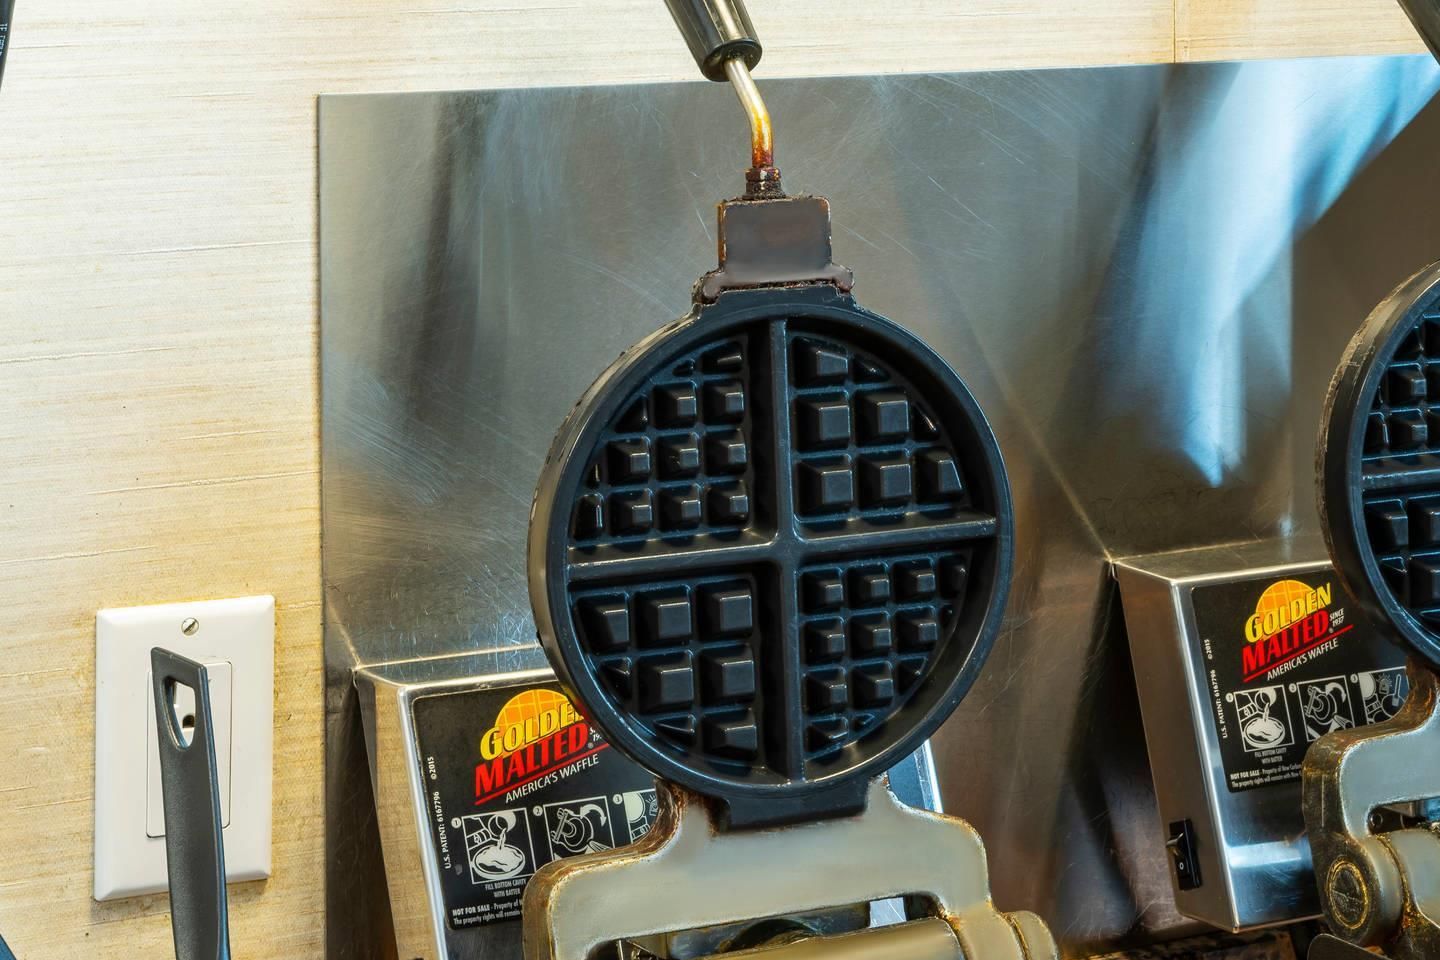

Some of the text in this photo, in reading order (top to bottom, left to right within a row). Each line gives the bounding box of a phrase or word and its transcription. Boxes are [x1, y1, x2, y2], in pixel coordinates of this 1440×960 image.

[1245, 582, 1332, 643] GOLDEN
[1329, 607, 1344, 621] SINCE
[1332, 615, 1344, 627] 1937
[1243, 609, 1329, 674] MALTED
[1267, 638, 1338, 680] AMERICA'S WAFFLE
[480, 702, 584, 760] GOLDE
[1216, 698, 1225, 725] PATENT:
[475, 722, 588, 798] MALTED
[505, 753, 600, 804] AMERICA'S WAFFLE
[432, 791, 452, 869] U.S. PATENT: 6167796
[452, 908, 464, 917] NOT
[465, 906, 476, 915] FOR
[477, 904, 490, 912] SALE
